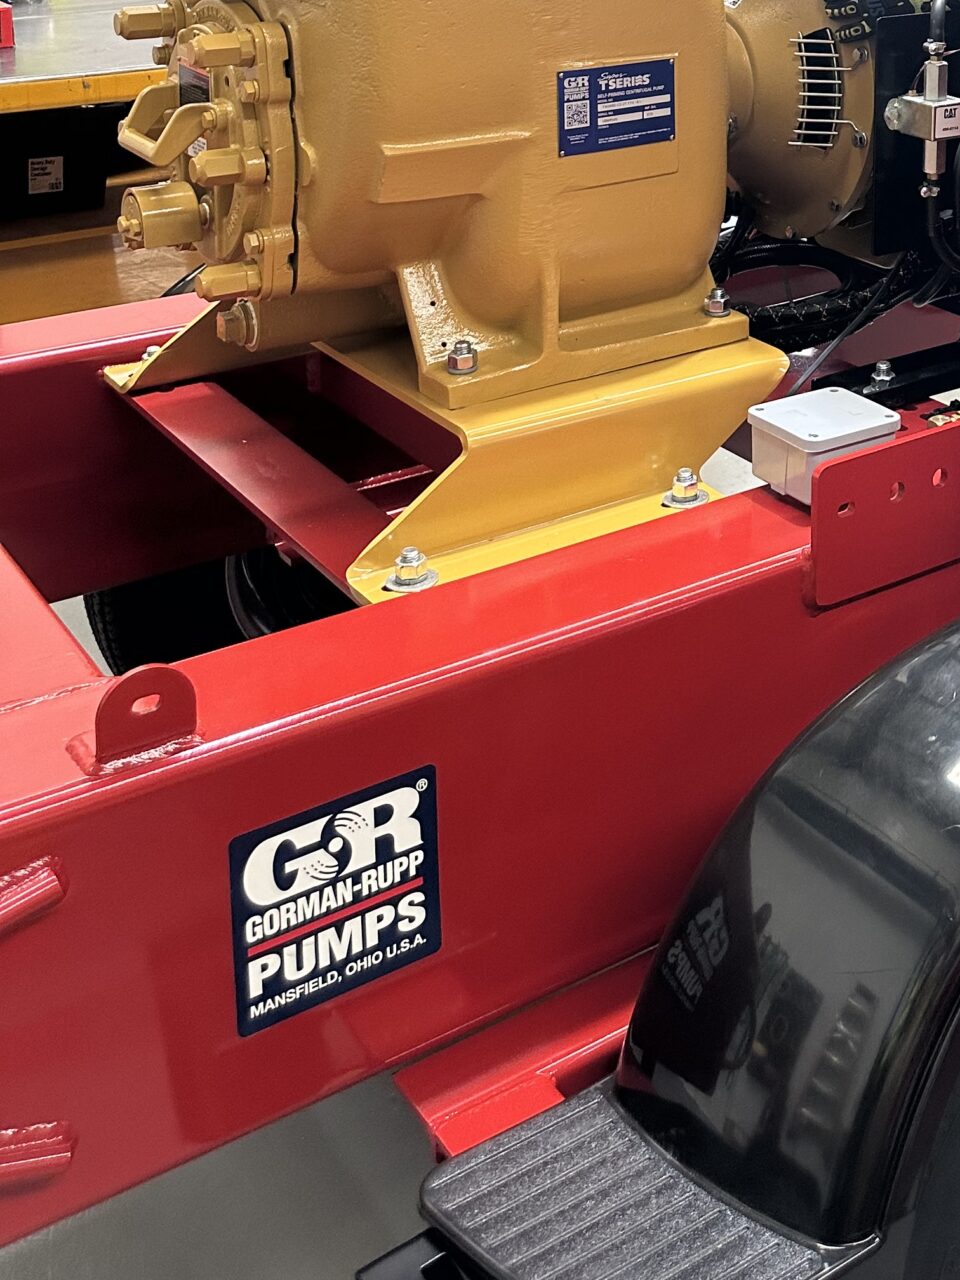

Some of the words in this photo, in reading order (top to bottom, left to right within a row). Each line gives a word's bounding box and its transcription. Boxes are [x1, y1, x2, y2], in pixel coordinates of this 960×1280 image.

[564, 92, 590, 101] PUMPS
[943, 108, 958, 119] CAT
[245, 849, 424, 944] GORMAN-RUPP
[248, 891, 426, 999] PUMPS
[250, 970, 343, 1019] MANSFIELD,
[345, 951, 383, 976] OHIO
[386, 933, 427, 959] U.S.A.
